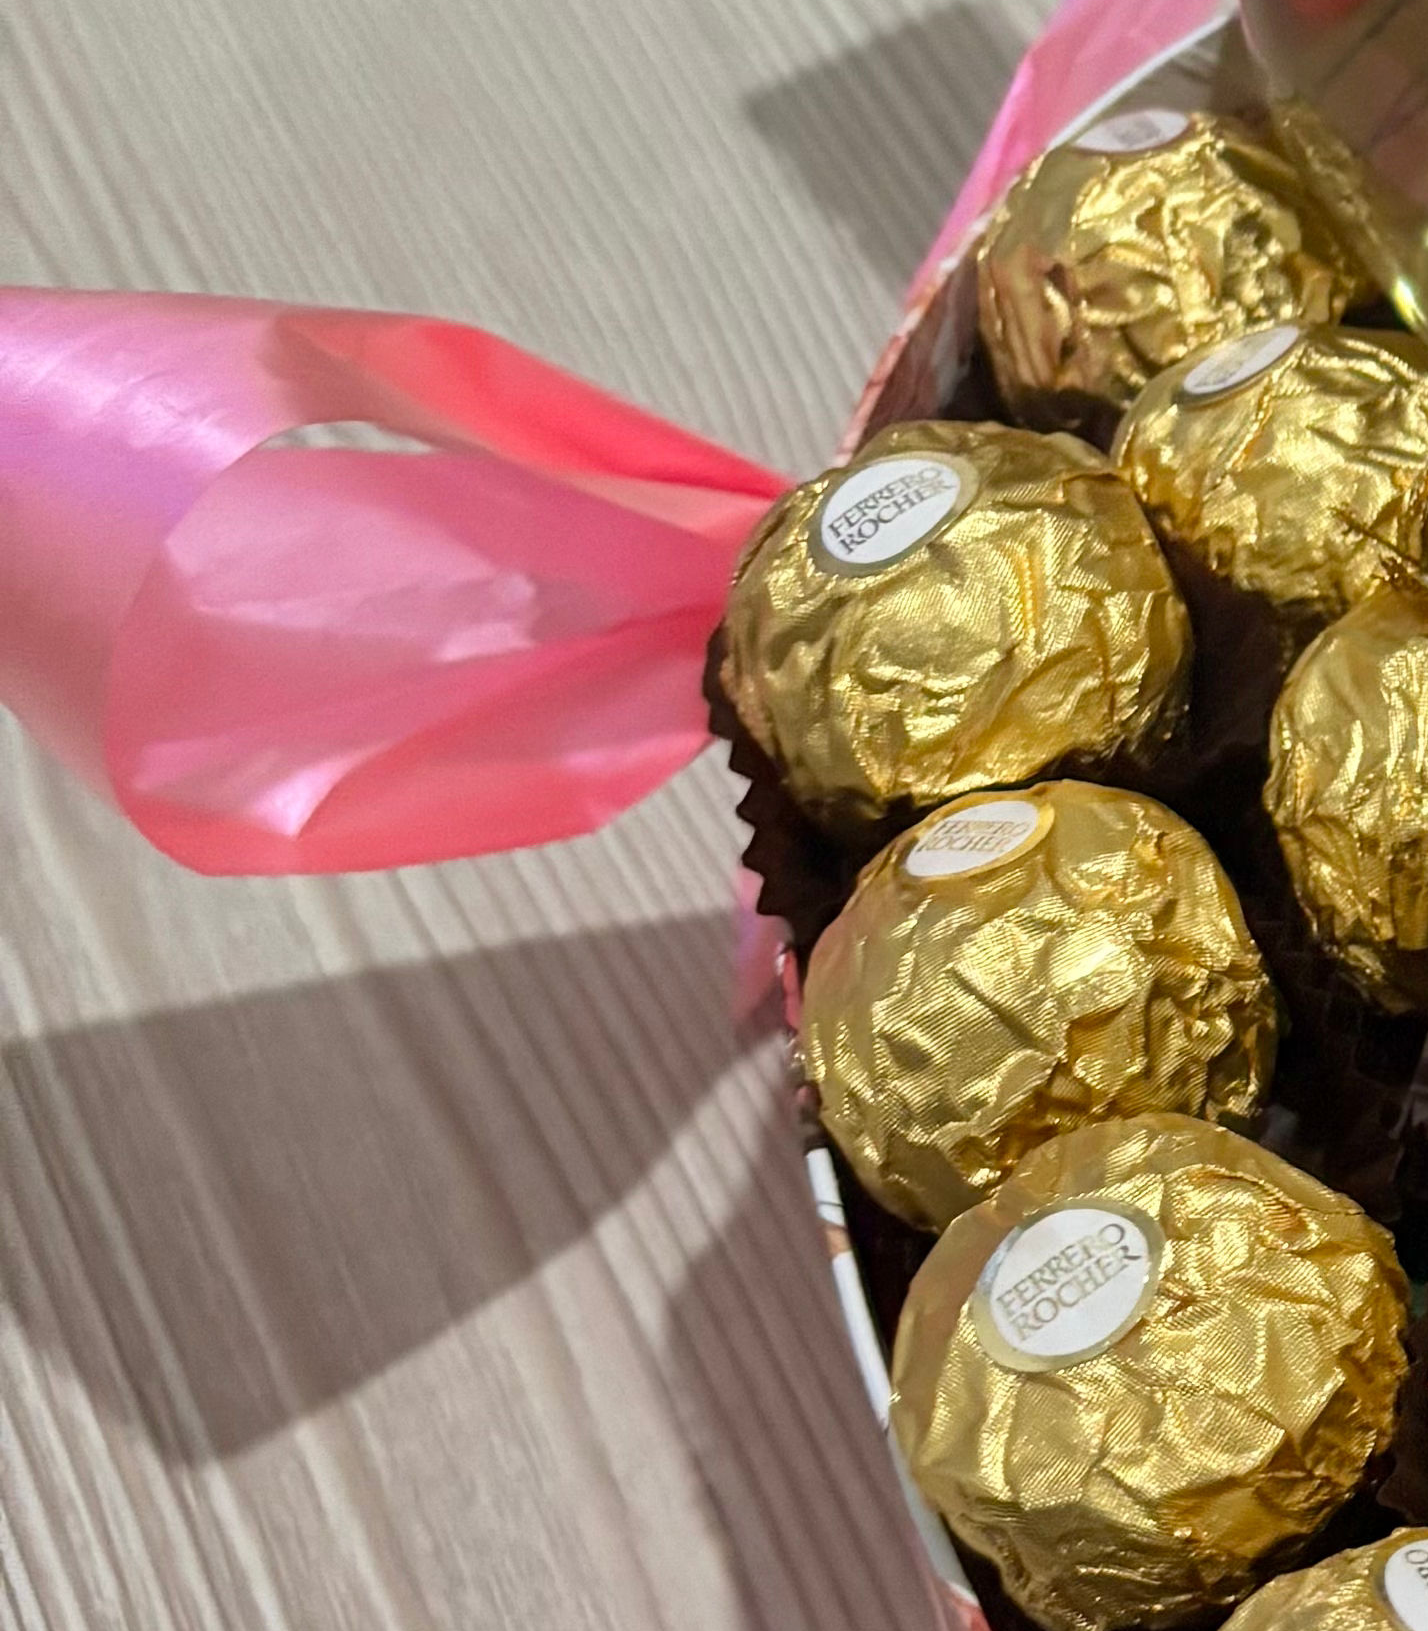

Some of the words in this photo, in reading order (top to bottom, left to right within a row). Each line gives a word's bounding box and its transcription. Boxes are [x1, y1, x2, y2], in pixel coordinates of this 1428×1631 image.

[828, 467, 942, 539] FERRERO
[840, 480, 957, 554] ROCHER
[996, 1223, 1126, 1316] FERRERO
[1011, 1245, 1142, 1341] ROCHER
